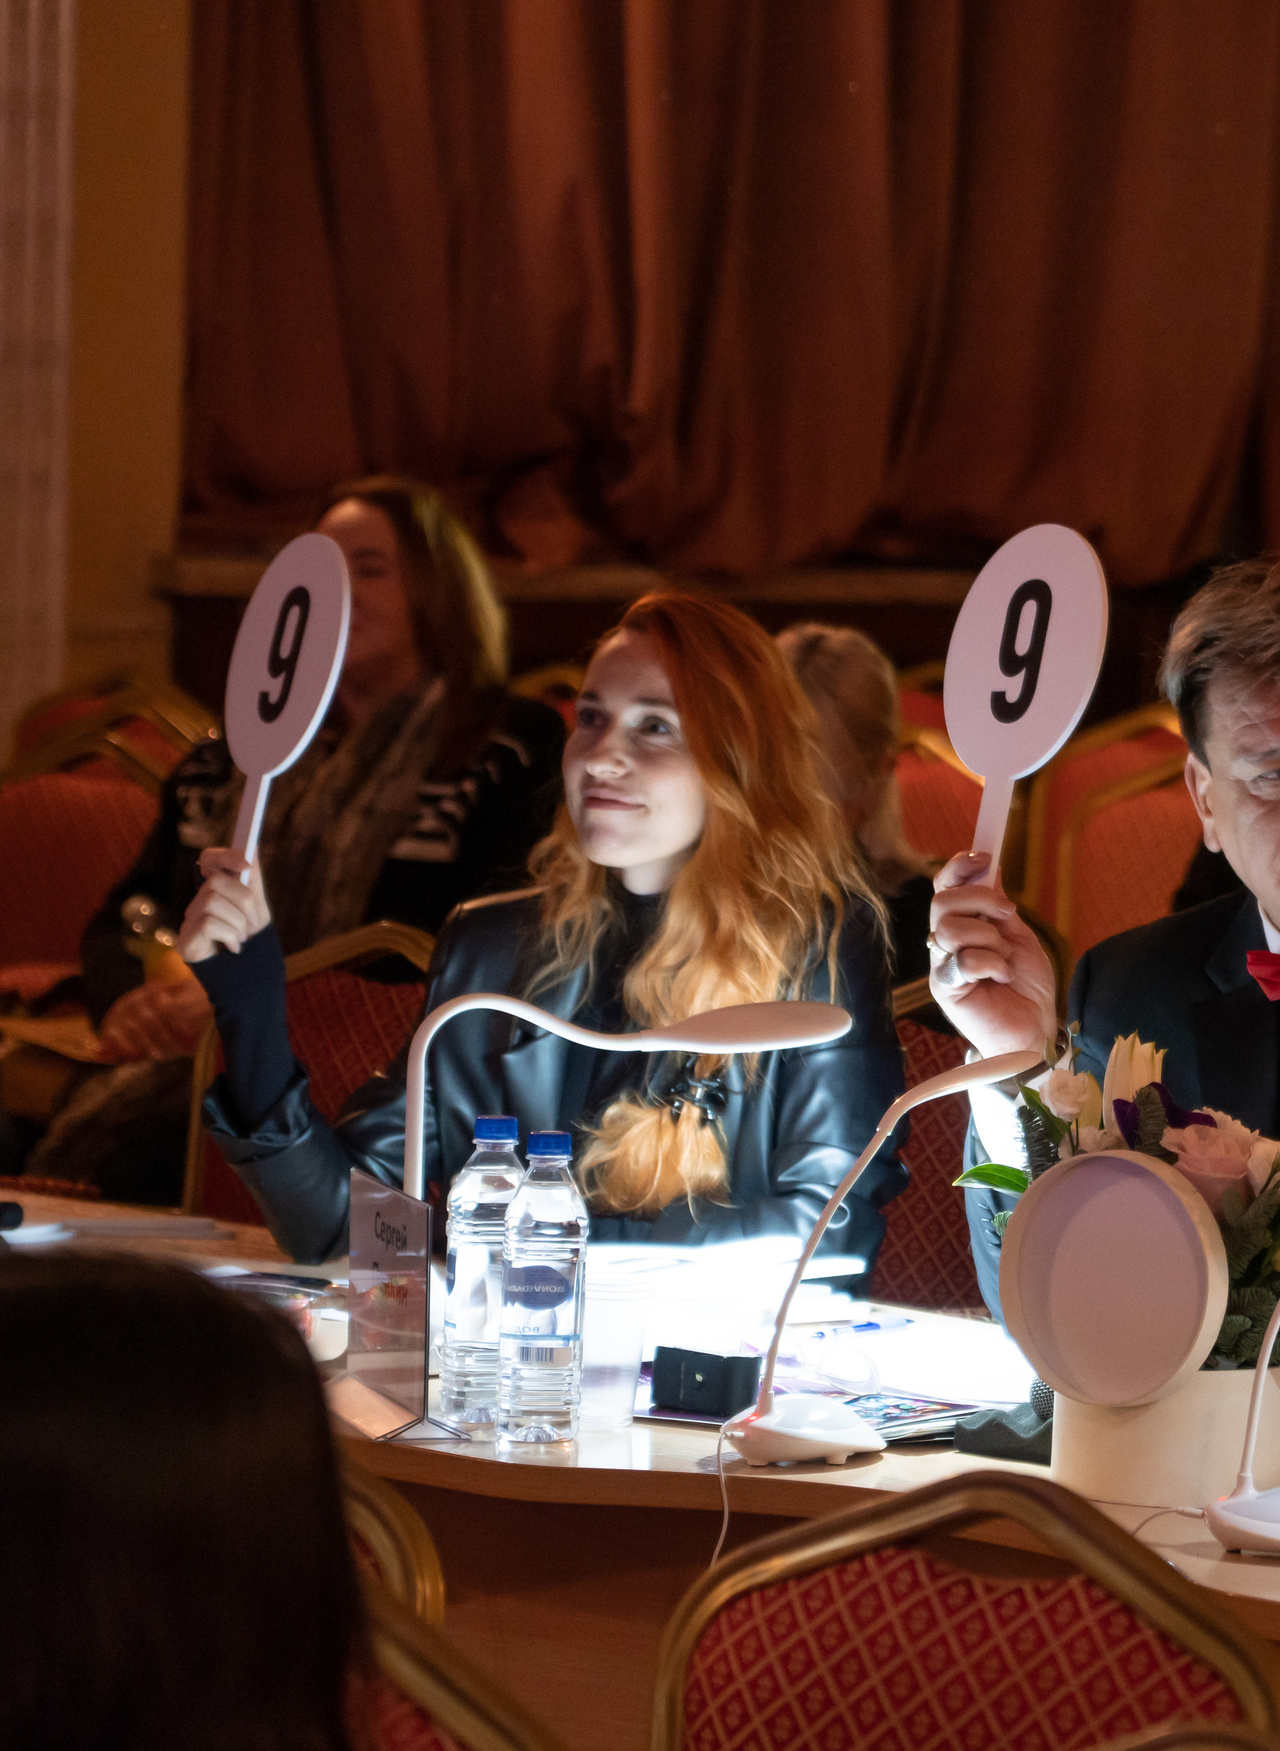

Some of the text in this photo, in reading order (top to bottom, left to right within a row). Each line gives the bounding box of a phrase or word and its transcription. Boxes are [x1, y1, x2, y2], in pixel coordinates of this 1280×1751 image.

[258, 586, 310, 723] 9
[990, 578, 1052, 723] 9
[374, 1210, 408, 1252] Сергей
